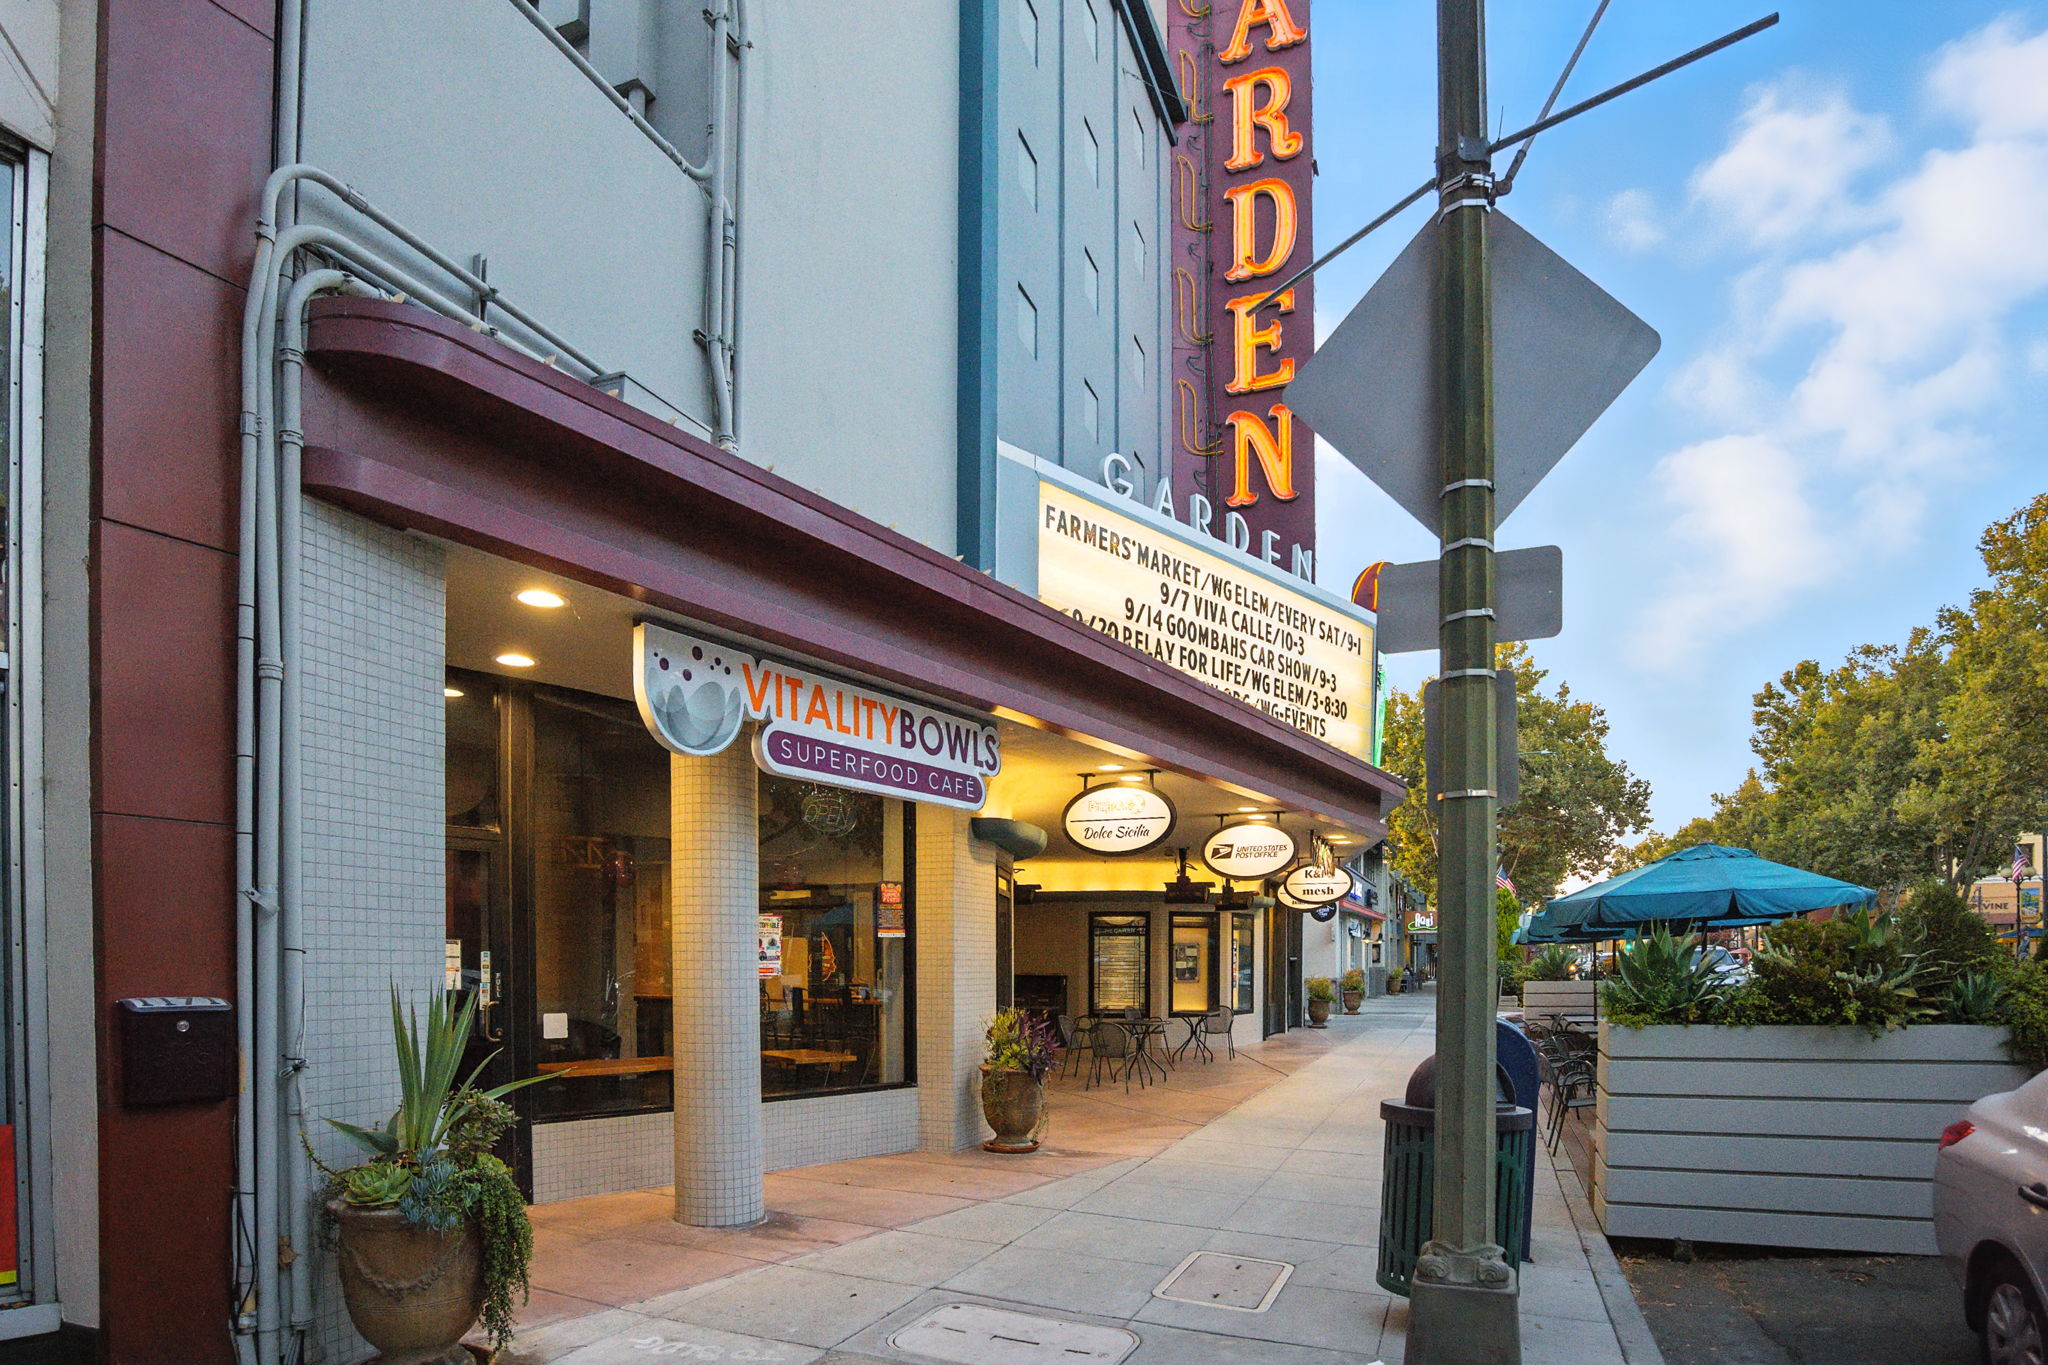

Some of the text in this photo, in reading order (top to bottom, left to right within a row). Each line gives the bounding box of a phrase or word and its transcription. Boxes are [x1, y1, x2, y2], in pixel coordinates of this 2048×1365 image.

[1103, 452, 1313, 584] GARDEN
[1160, 582, 1190, 612] 9/7
[1194, 595, 1228, 627] VIVA
[1123, 626, 1175, 663] RELAY
[1179, 646, 1208, 674] FOR
[1125, 597, 1163, 632] 9/14
[1167, 614, 1247, 660] GOOMBAHS
[1250, 644, 1274, 671] CAR
[781, 739, 975, 798] SUPERFOOD CAFÉ
[1084, 824, 1150, 840] Dolce Sicilia
[1264, 844, 1288, 852] STATES
[1302, 886, 1334, 896] mesh
